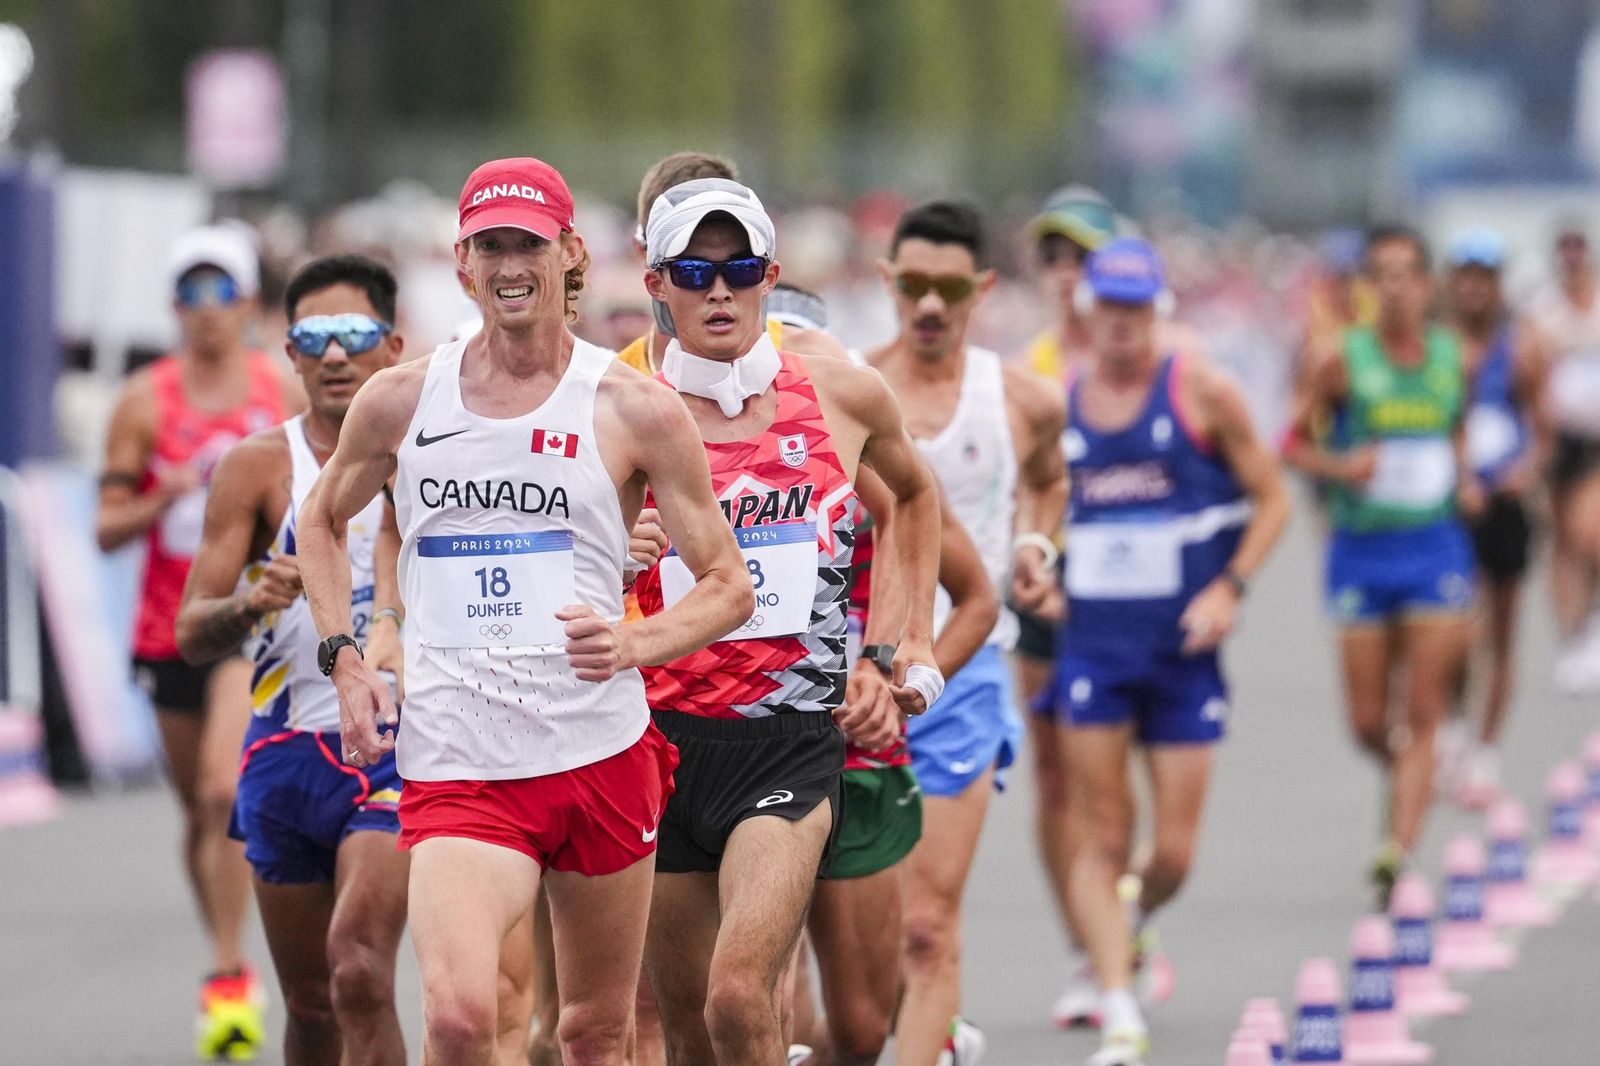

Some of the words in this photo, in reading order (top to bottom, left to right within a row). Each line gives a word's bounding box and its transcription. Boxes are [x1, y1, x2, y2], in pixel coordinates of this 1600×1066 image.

[472, 184, 545, 205] CANADA
[420, 478, 569, 519] CANADA
[452, 540, 491, 551] PARIS
[495, 538, 531, 549] 2024
[743, 531, 777, 543] 2024
[474, 567, 511, 598] 18
[467, 602, 523, 618] DUNFEE
